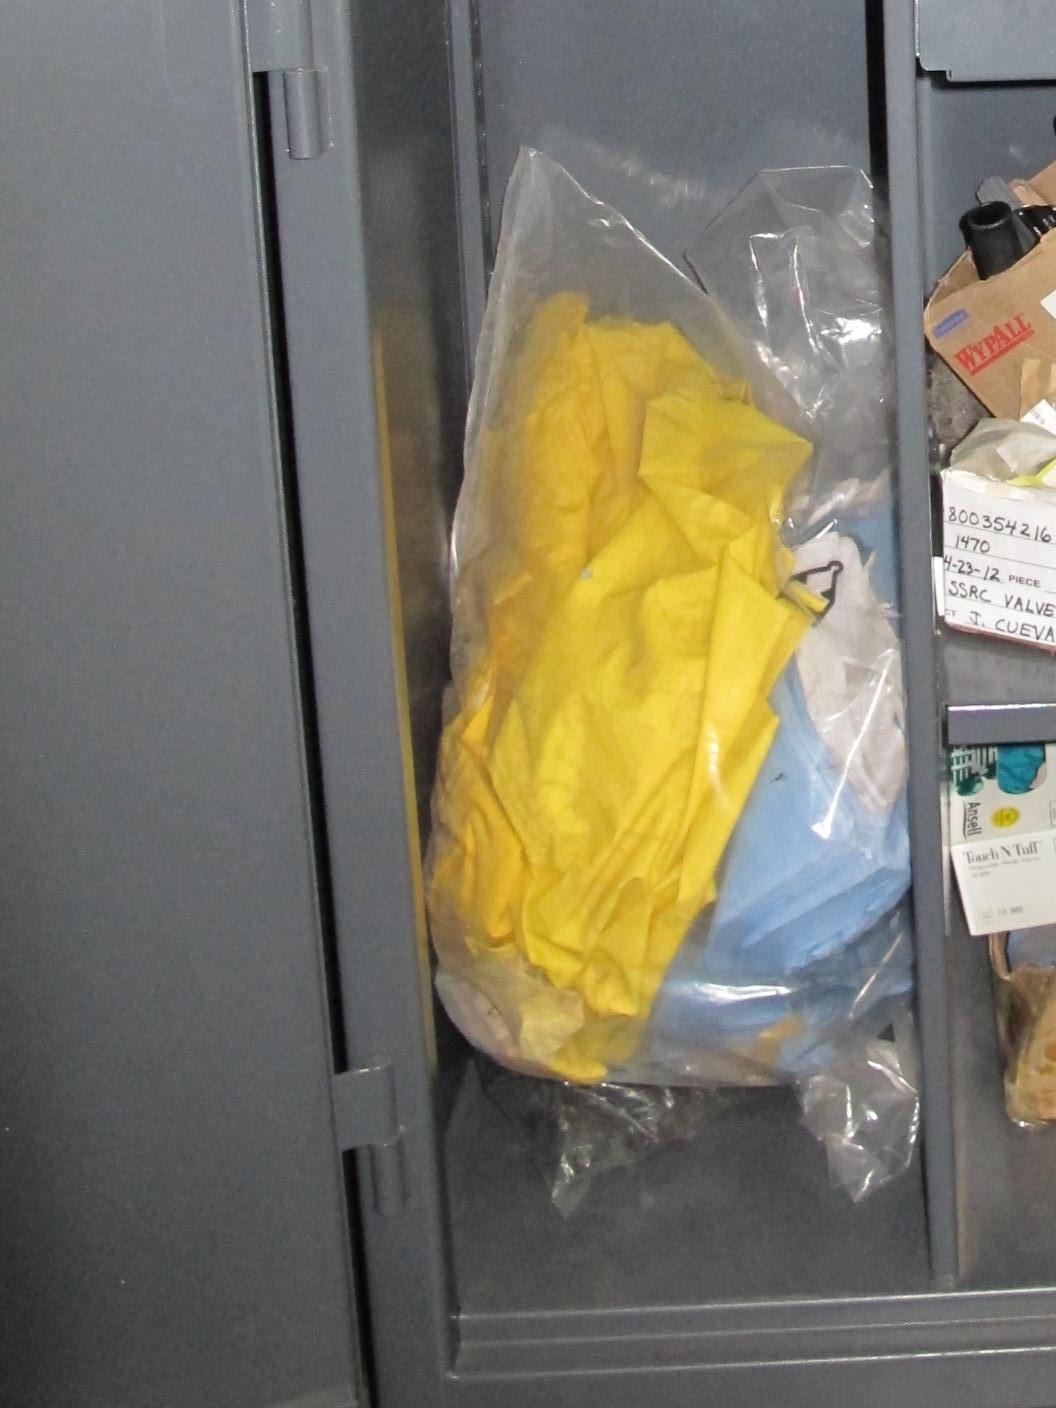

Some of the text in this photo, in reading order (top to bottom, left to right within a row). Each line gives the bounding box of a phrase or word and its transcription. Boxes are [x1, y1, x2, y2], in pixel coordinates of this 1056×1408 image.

[948, 506, 1052, 543] 800354216
[955, 534, 991, 553] 1470
[943, 554, 1000, 581] 4-23-12
[1008, 574, 1041, 588] PIECE
[948, 580, 992, 604] SSRC
[1004, 594, 1056, 618] VALVE
[994, 618, 1056, 643] CUEVA
[967, 801, 983, 836] Ansell
[963, 846, 999, 865] Touch
[1012, 840, 1040, 856] Tuff
